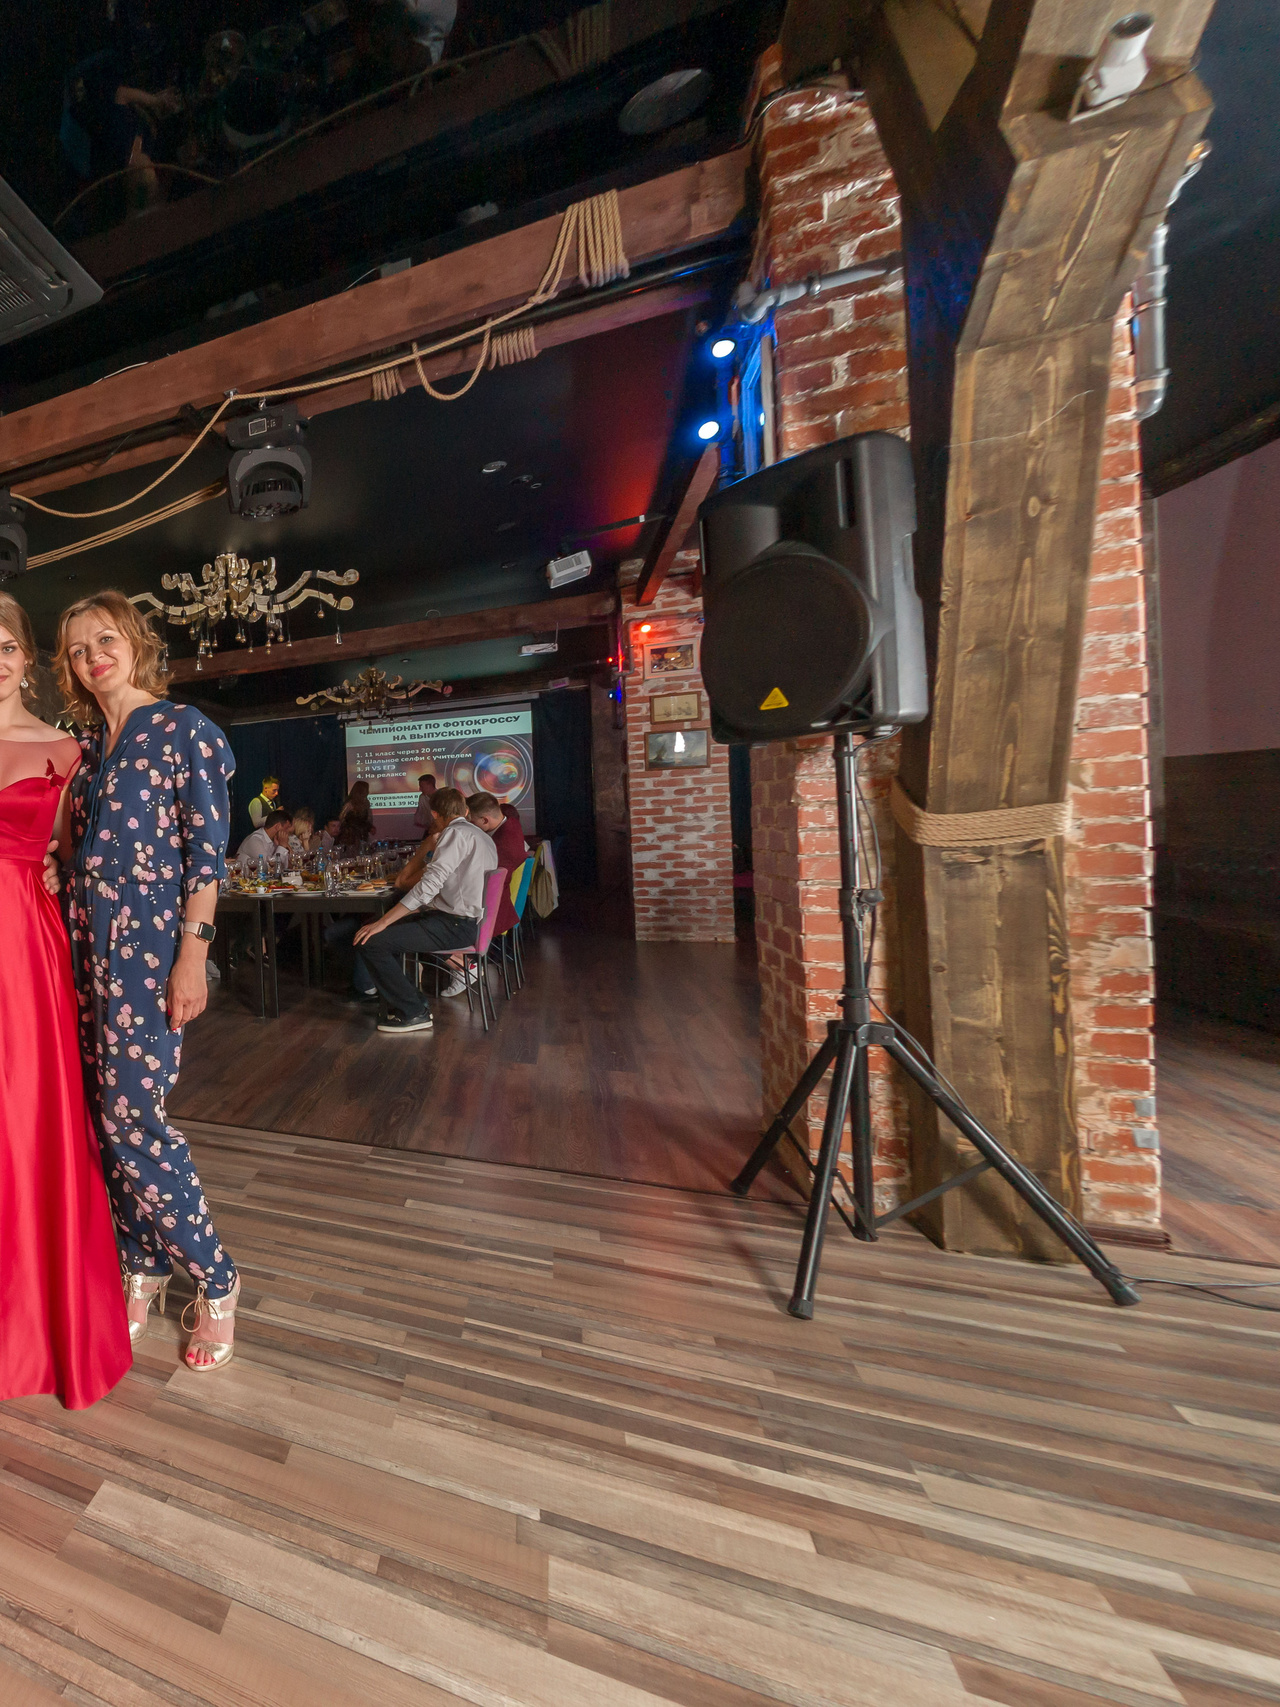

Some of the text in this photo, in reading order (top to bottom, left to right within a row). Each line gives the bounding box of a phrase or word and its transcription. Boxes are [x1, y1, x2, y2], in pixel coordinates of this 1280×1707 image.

[359, 715, 520, 735] ЧЕМПИОНАТ ПО ФОТОКРОССУ
[410, 728, 482, 740] ВЫПУСКНОМ
